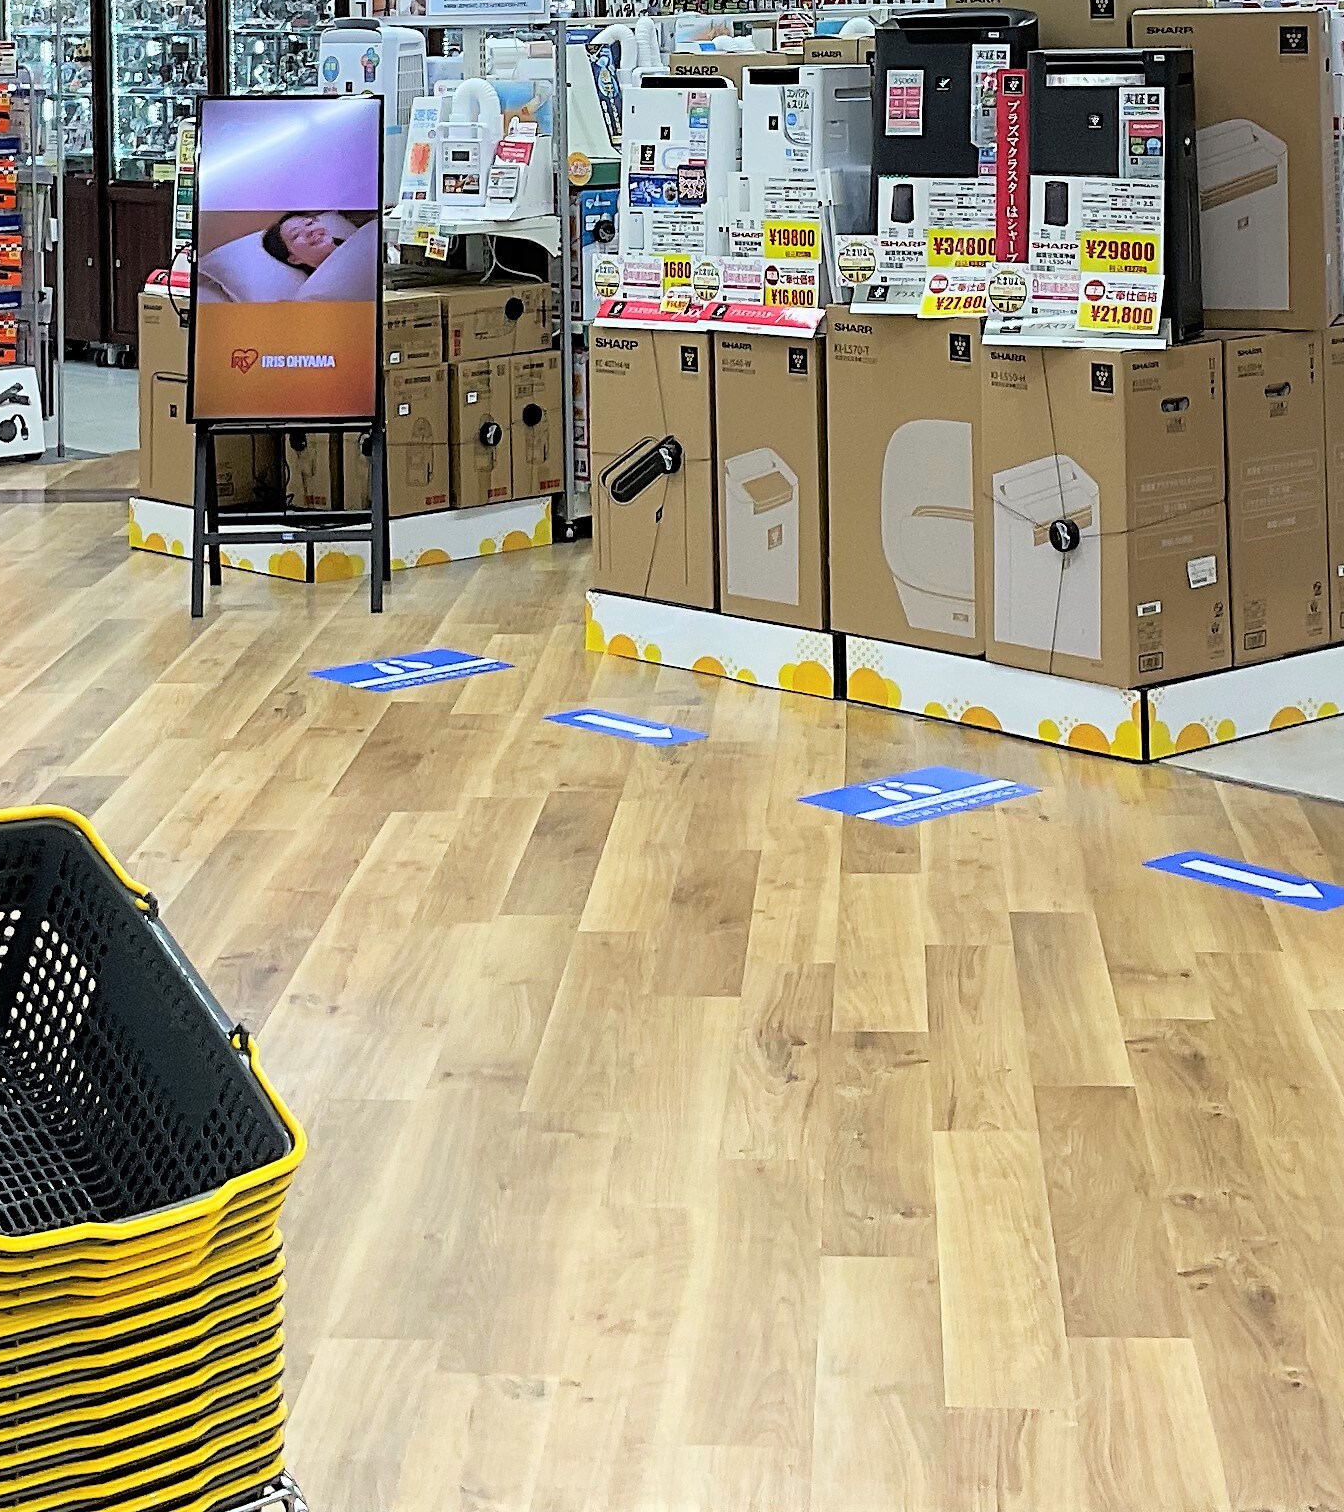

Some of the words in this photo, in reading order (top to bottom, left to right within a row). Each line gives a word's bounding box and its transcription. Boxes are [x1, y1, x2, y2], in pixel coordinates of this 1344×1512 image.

[1146, 26, 1193, 34] SHARP
[880, 240, 927, 248] SHARP
[1031, 241, 1079, 250] SHARP
[1085, 239, 1155, 262] ¥29800
[1091, 306, 1153, 323] ¥21,800
[834, 322, 872, 334] SHARP
[595, 338, 638, 350] SHARP
[722, 342, 752, 350] SHARP
[261, 355, 286, 368] IRIS
[288, 354, 336, 368] OHYAMA
[990, 352, 1027, 362] SHARP
